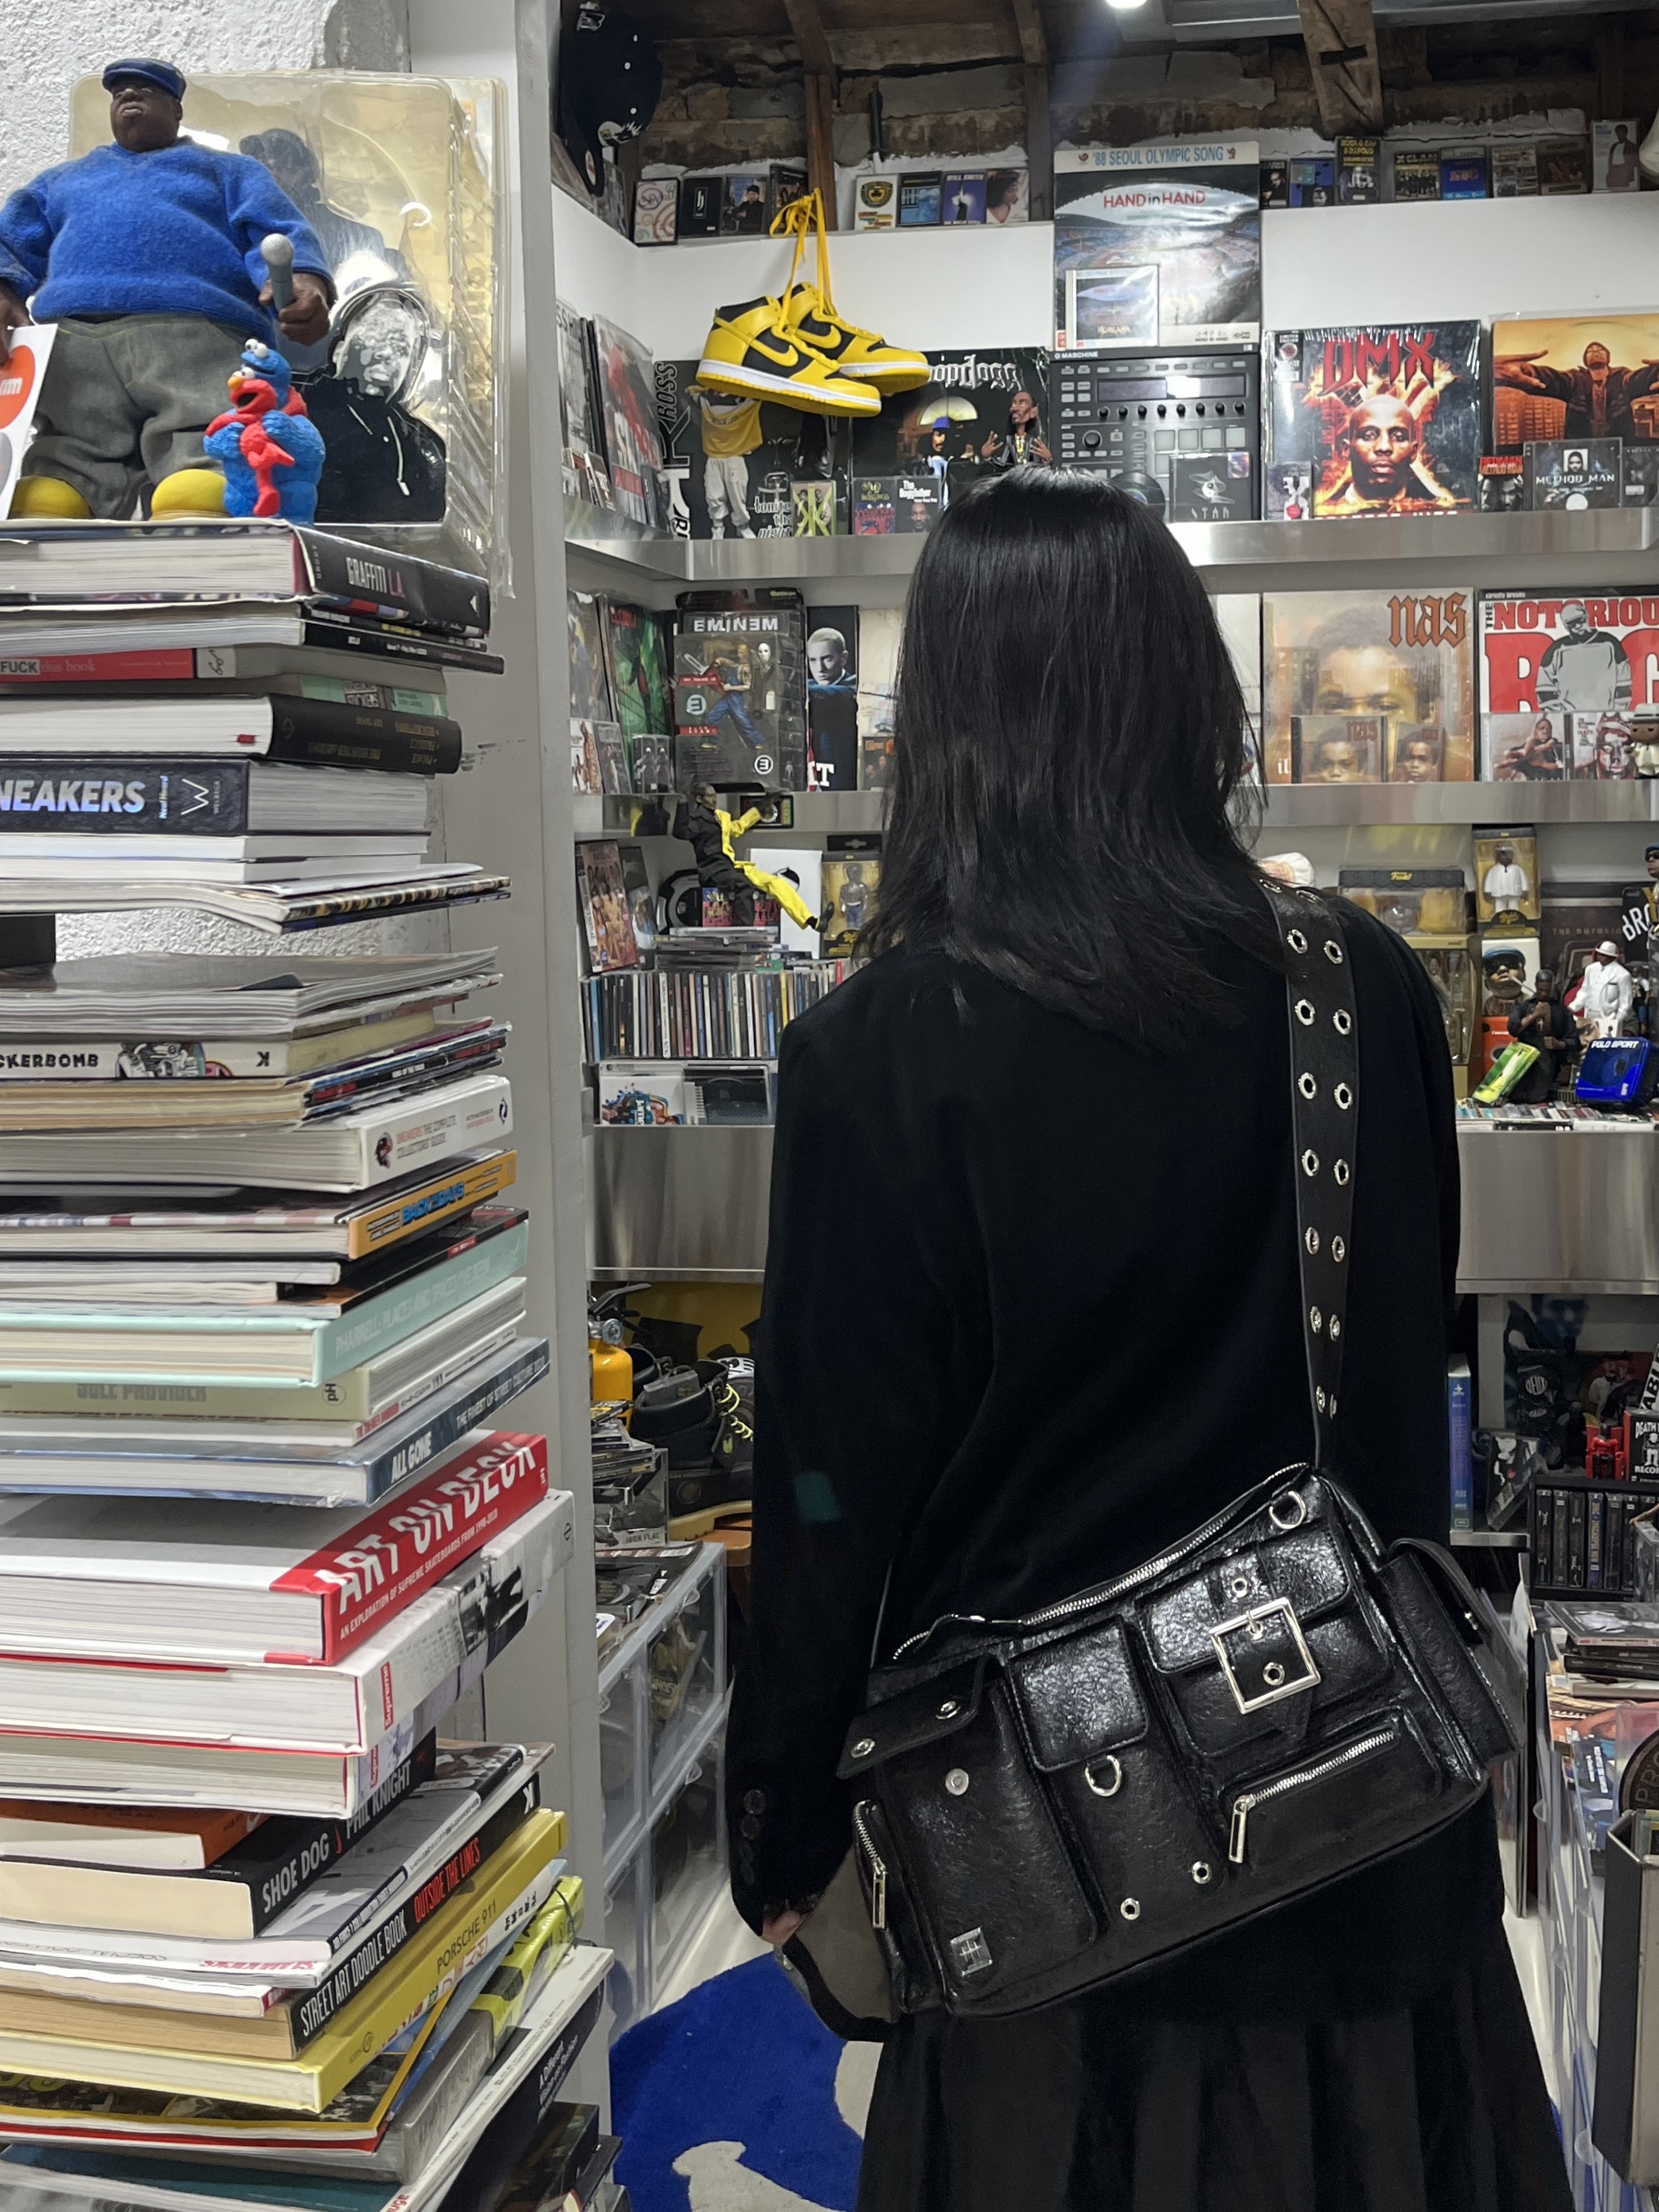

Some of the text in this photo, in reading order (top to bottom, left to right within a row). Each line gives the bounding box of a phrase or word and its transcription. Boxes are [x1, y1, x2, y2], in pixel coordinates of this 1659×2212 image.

[1109, 150, 1143, 166] SEOUL
[1146, 147, 1191, 164] OLYMPIC
[1193, 146, 1224, 162] SONG
[1104, 190, 1205, 209] HAND in HAND
[1317, 330, 1439, 397] DMX
[1536, 474, 1614, 485] METHOD MAN
[345, 557, 388, 594] GRAFFITI
[693, 617, 779, 632] EMINEM
[1388, 592, 1467, 648] nas
[1485, 604, 1493, 629] THE
[1493, 597, 1659, 630] NOTRIOU
[1, 661, 38, 674] FUCK
[66, 660, 96, 673] book
[0, 780, 146, 813] NEAKERS
[159, 776, 170, 819] Neal Heard
[1611, 1040, 1639, 1049] SPORT
[401, 1198, 430, 1225] BACK
[436, 1182, 466, 1208] DAYS
[456, 1414, 467, 1430] THE
[467, 1401, 486, 1425] FINEST
[494, 1378, 513, 1402] STREET
[513, 1364, 534, 1390] CULTURE
[1635, 1421, 1653, 1438] DEATH
[391, 1430, 432, 1484] ALL GONE
[318, 1441, 536, 1615] ART ON DECK
[340, 1626, 349, 1640] AN
[349, 1598, 390, 1636] EXPLORATION
[389, 1589, 396, 1601] OF
[398, 1569, 424, 1595] SUPREME
[424, 1537, 461, 1574] SKATEBOARDS
[461, 1526, 475, 1547] FROM
[382, 1664, 392, 1728] Supreme
[345, 1759, 412, 1840] PHIL KNIGHT
[262, 1861, 298, 1913] SHOE
[301, 1833, 330, 1880] DOG
[413, 1837, 482, 1925] OUTSIDE THE LINES
[436, 1918, 481, 1975] PORSCHE
[481, 1899, 498, 1925] 911
[300, 1981, 333, 2037] STREET
[334, 1963, 351, 2005] ART
[350, 1932, 385, 1987] DOODLE
[384, 1909, 408, 1955] BOOK
